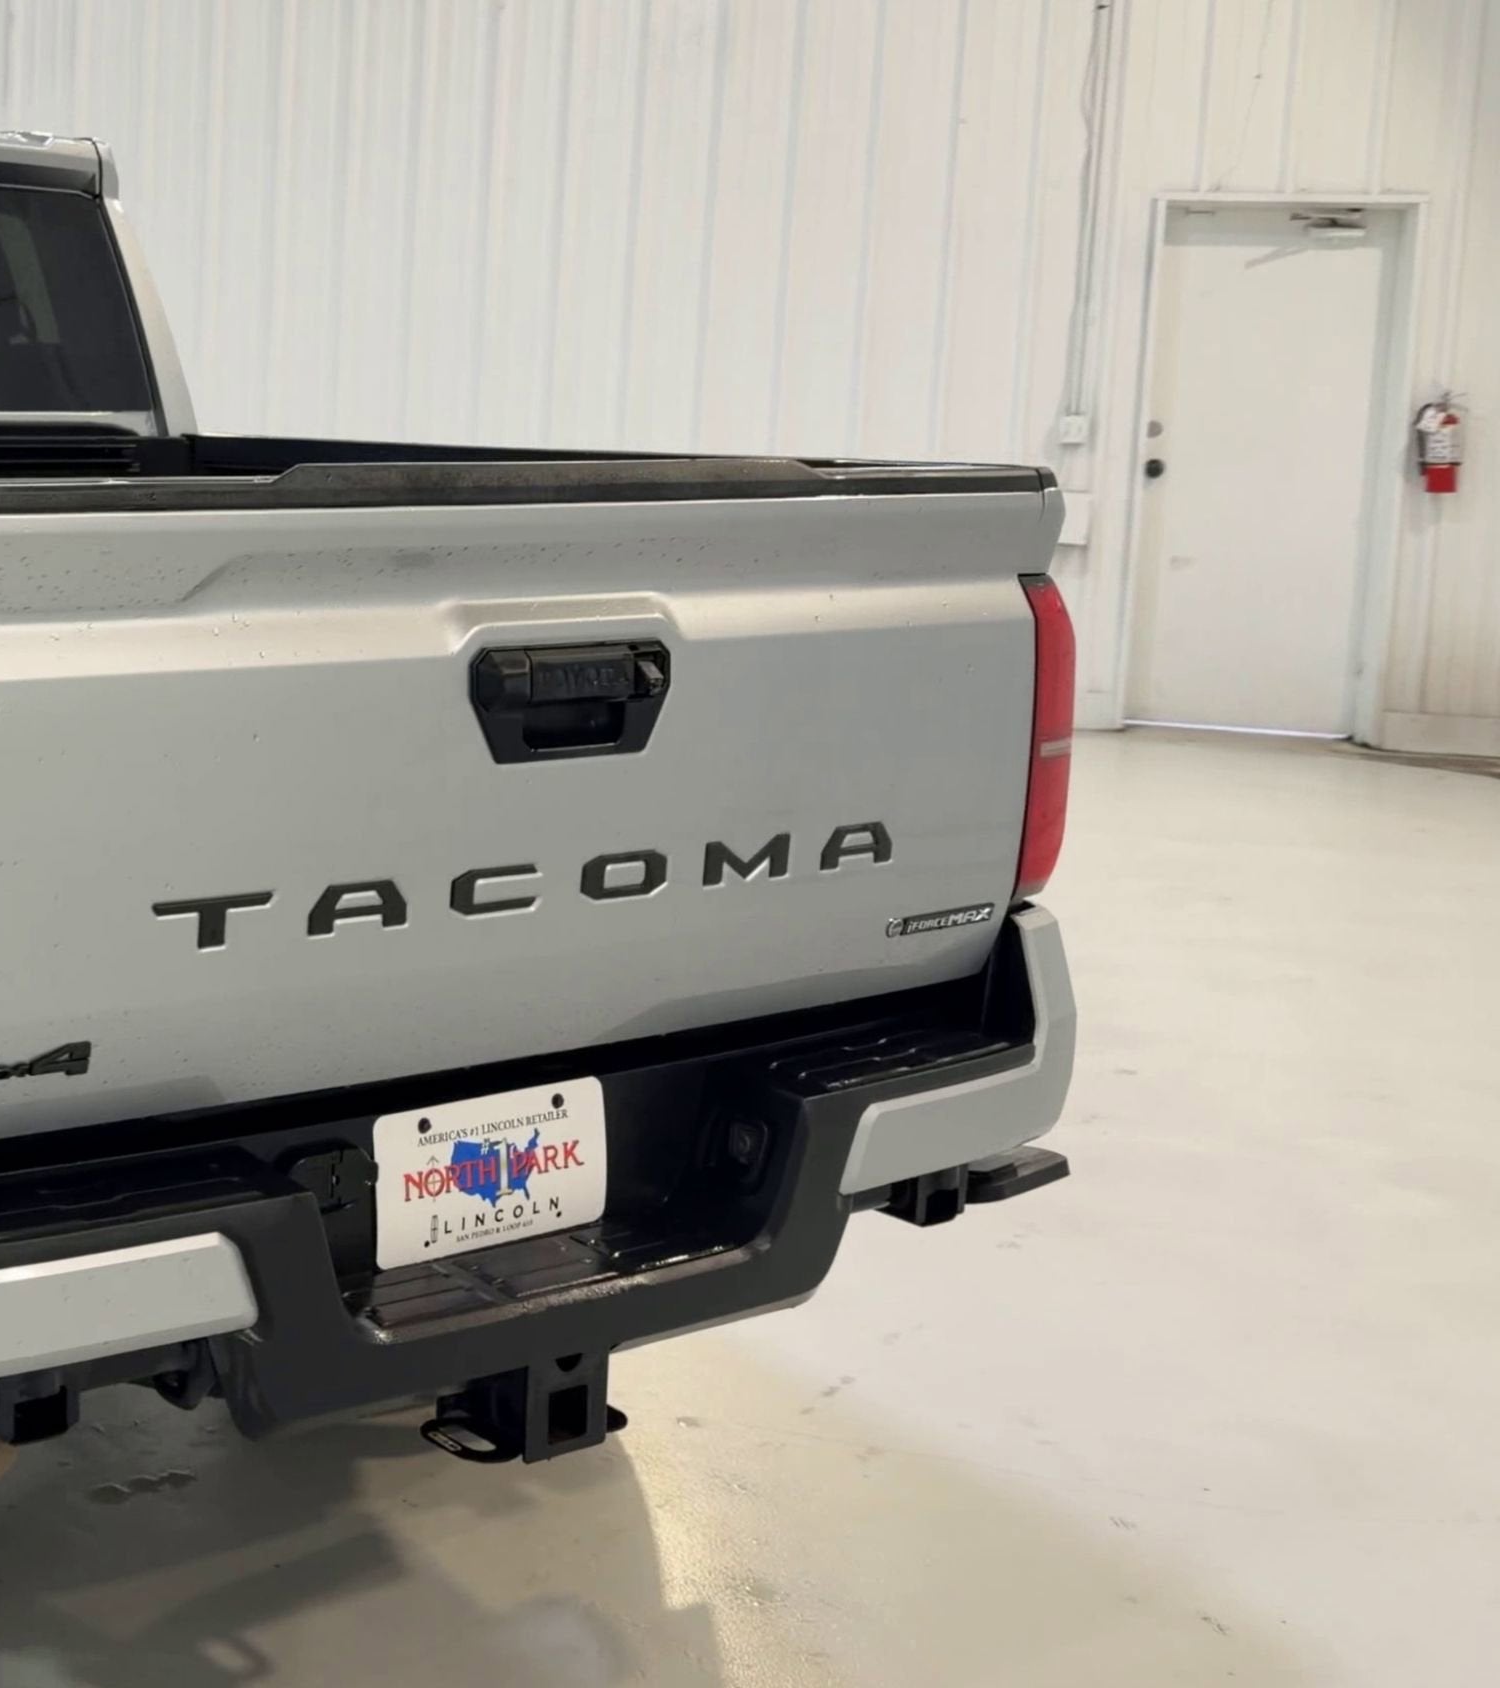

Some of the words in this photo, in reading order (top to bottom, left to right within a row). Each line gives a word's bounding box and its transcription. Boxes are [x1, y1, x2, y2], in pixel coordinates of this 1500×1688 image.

[152, 822, 892, 950] TACOMA
[417, 1127, 468, 1148] AMERICA'S
[470, 1126, 480, 1137] #1
[482, 1116, 525, 1134] LINCOLN
[526, 1109, 568, 1126] RETAILER
[403, 1156, 497, 1202] NORTH
[511, 1140, 584, 1179] PARK
[444, 1197, 559, 1234] LINCOLN
